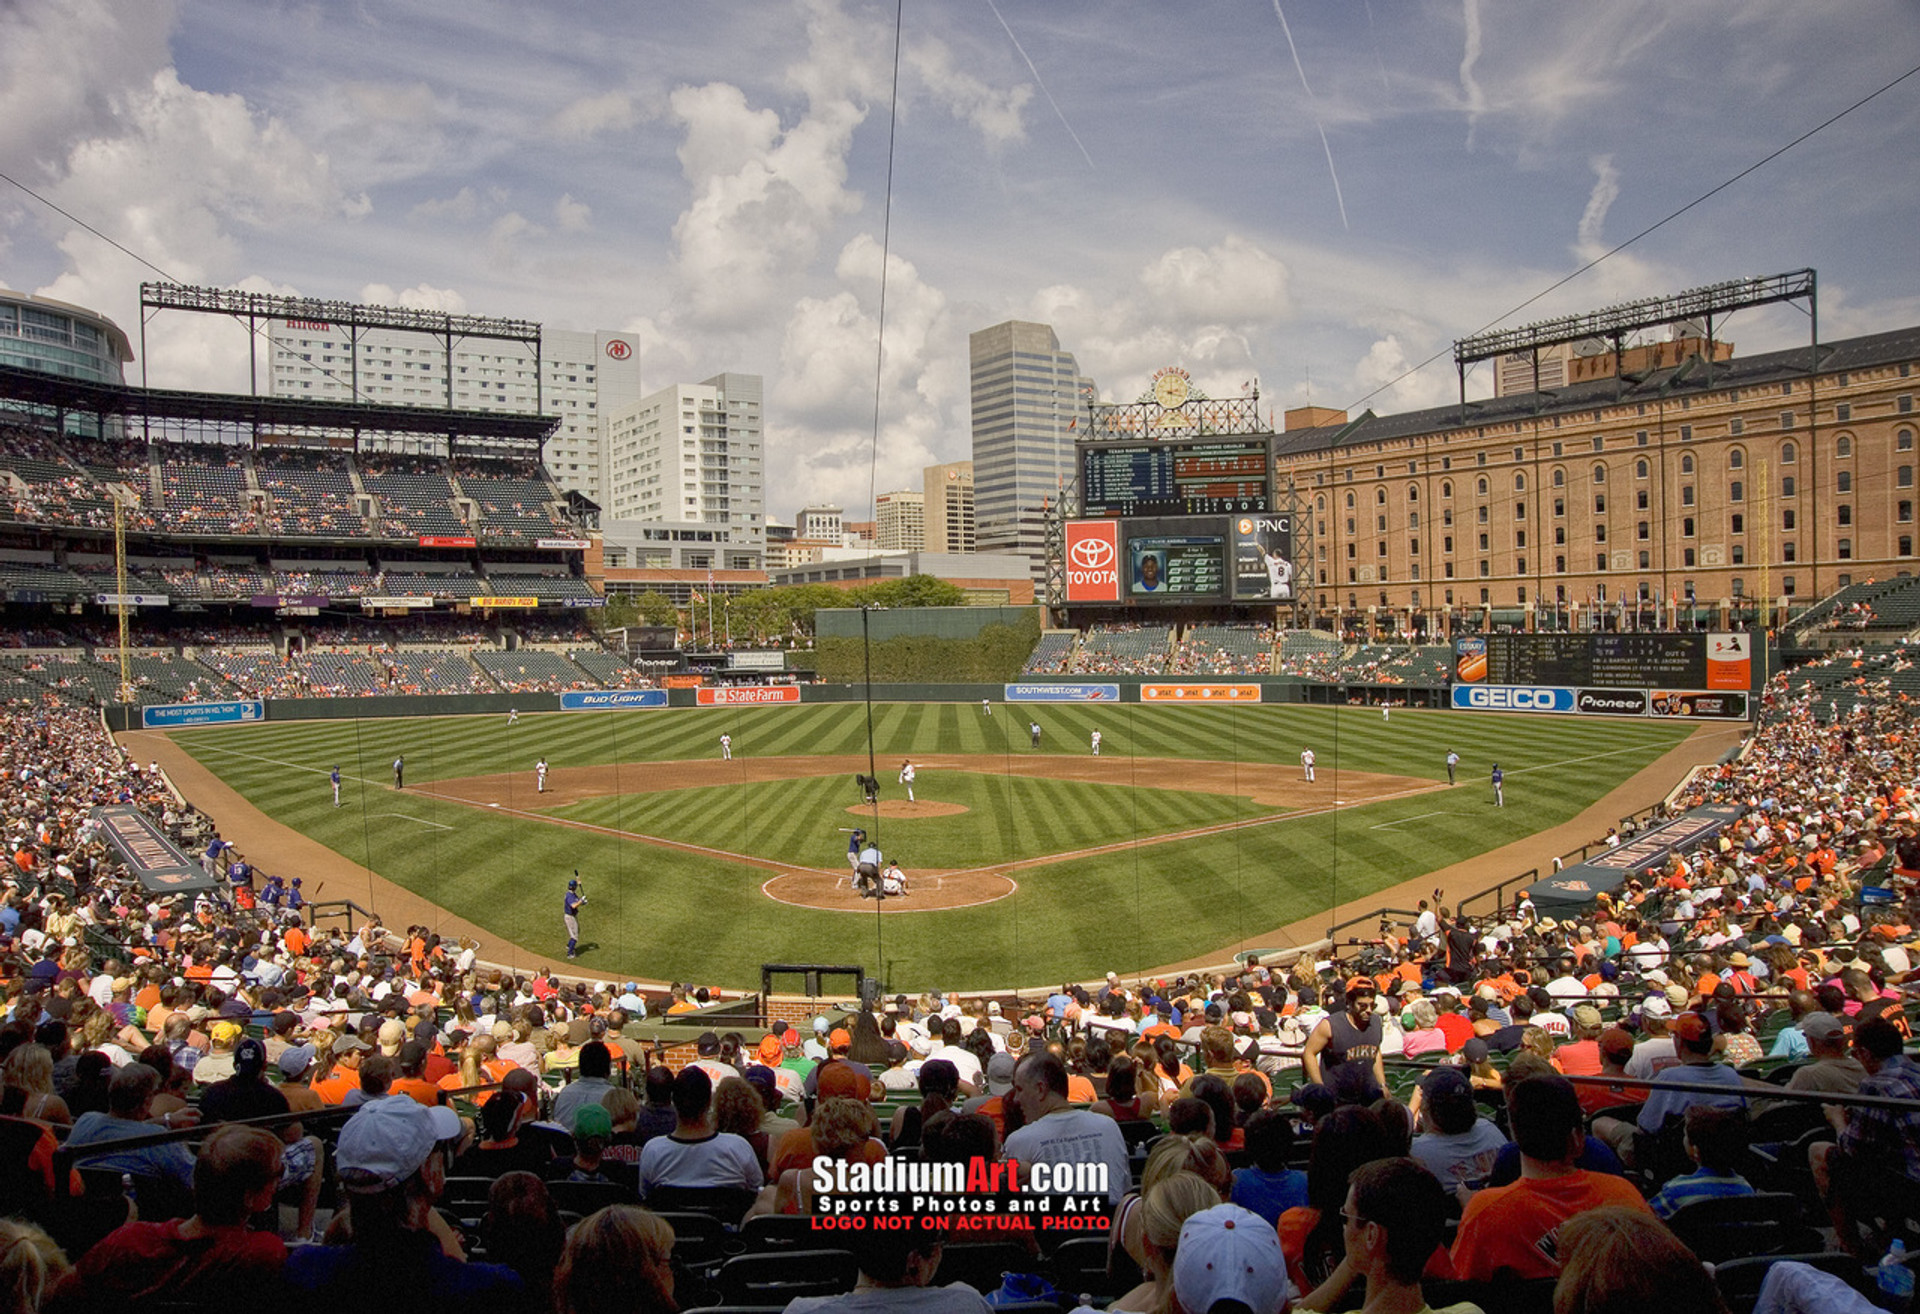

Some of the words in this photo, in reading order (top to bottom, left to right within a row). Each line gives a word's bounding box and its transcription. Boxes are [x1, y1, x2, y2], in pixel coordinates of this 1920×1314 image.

[1225, 503, 1233, 511] 0
[1241, 502, 1248, 510] 0
[1257, 501, 1265, 510] 2
[1256, 519, 1289, 533] PNC
[1067, 570, 1118, 584] TOYOTA
[1278, 566, 1285, 577] 8
[634, 657, 679, 666] Pioneer
[583, 695, 607, 703] BUD
[611, 694, 645, 703] LIGHT
[728, 689, 755, 702] State
[756, 689, 784, 701] Farm
[1468, 688, 1556, 709] GEICO
[1579, 694, 1643, 709] Pioneer
[155, 709, 166, 717] THE
[167, 708, 182, 716] MOST
[1346, 1044, 1377, 1061] NIKE
